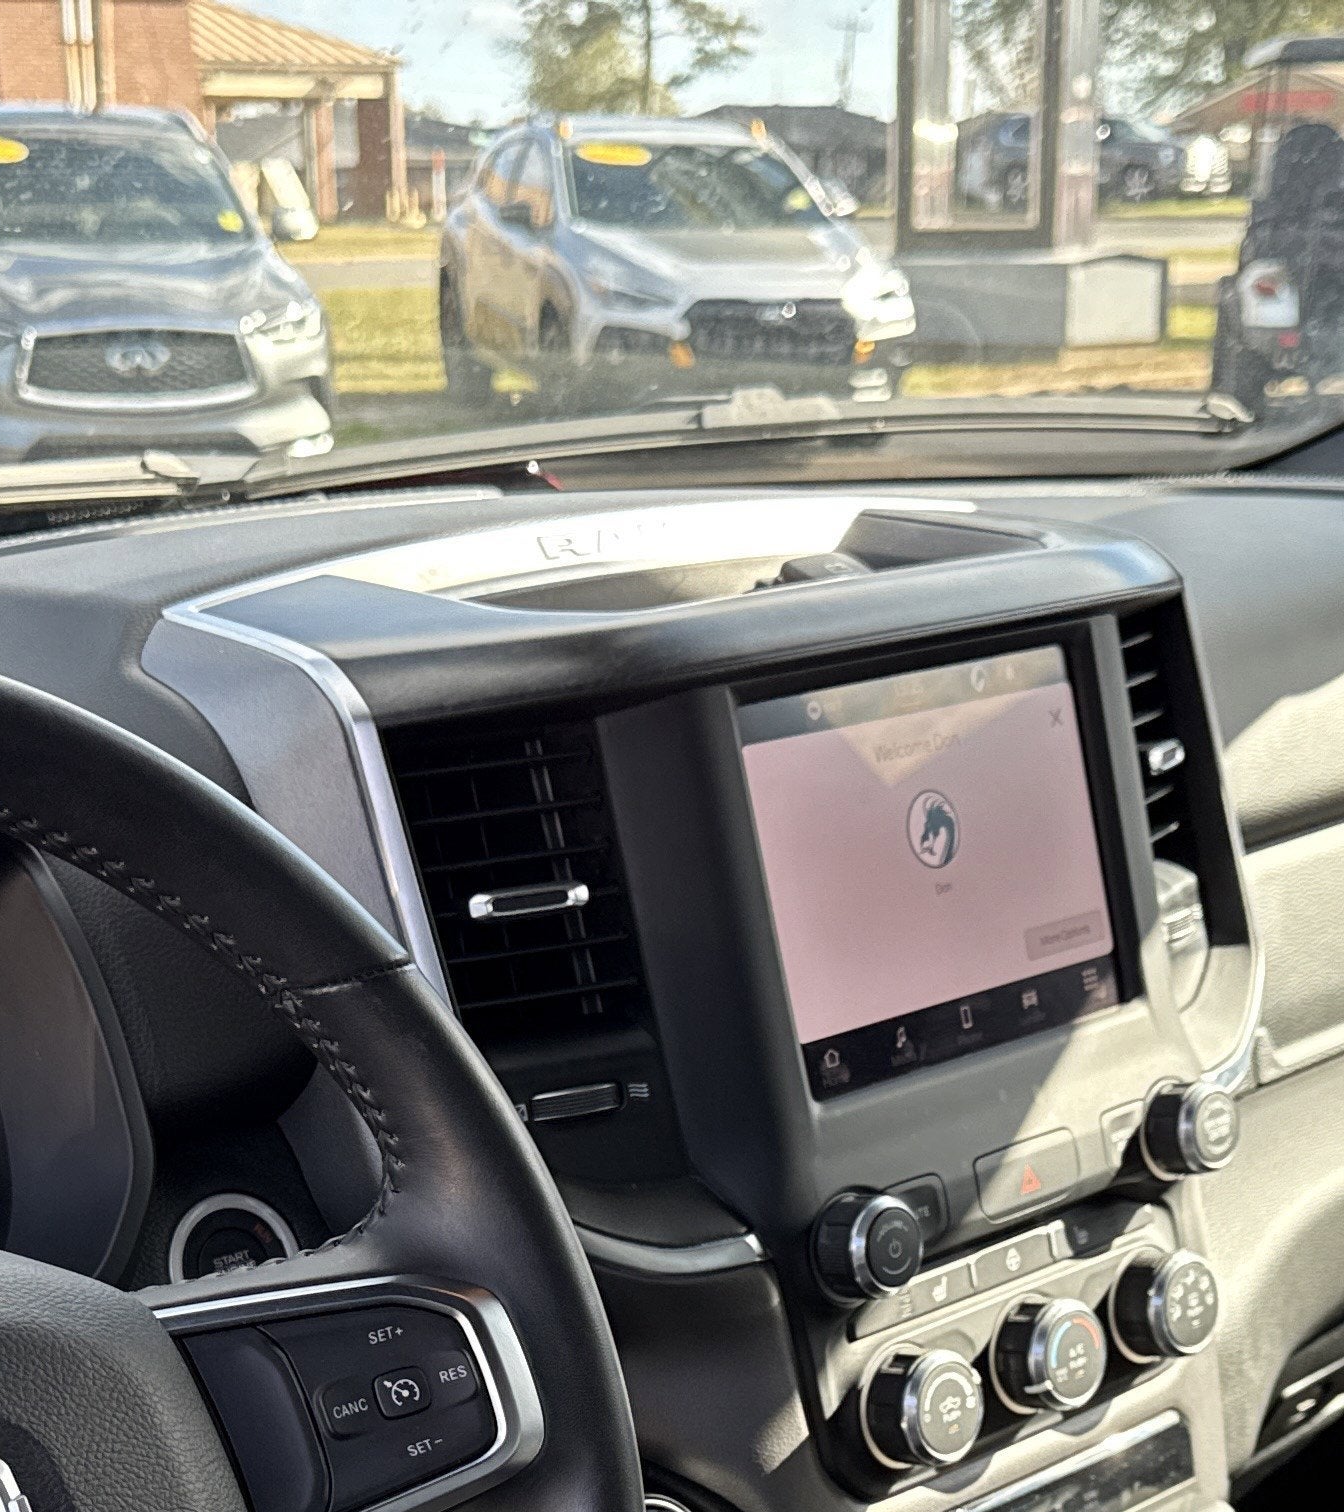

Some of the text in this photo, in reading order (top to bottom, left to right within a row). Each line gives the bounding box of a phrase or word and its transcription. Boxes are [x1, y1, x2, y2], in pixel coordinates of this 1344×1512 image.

[212, 1250, 250, 1268] START
[332, 1363, 468, 1419] CANC RES
